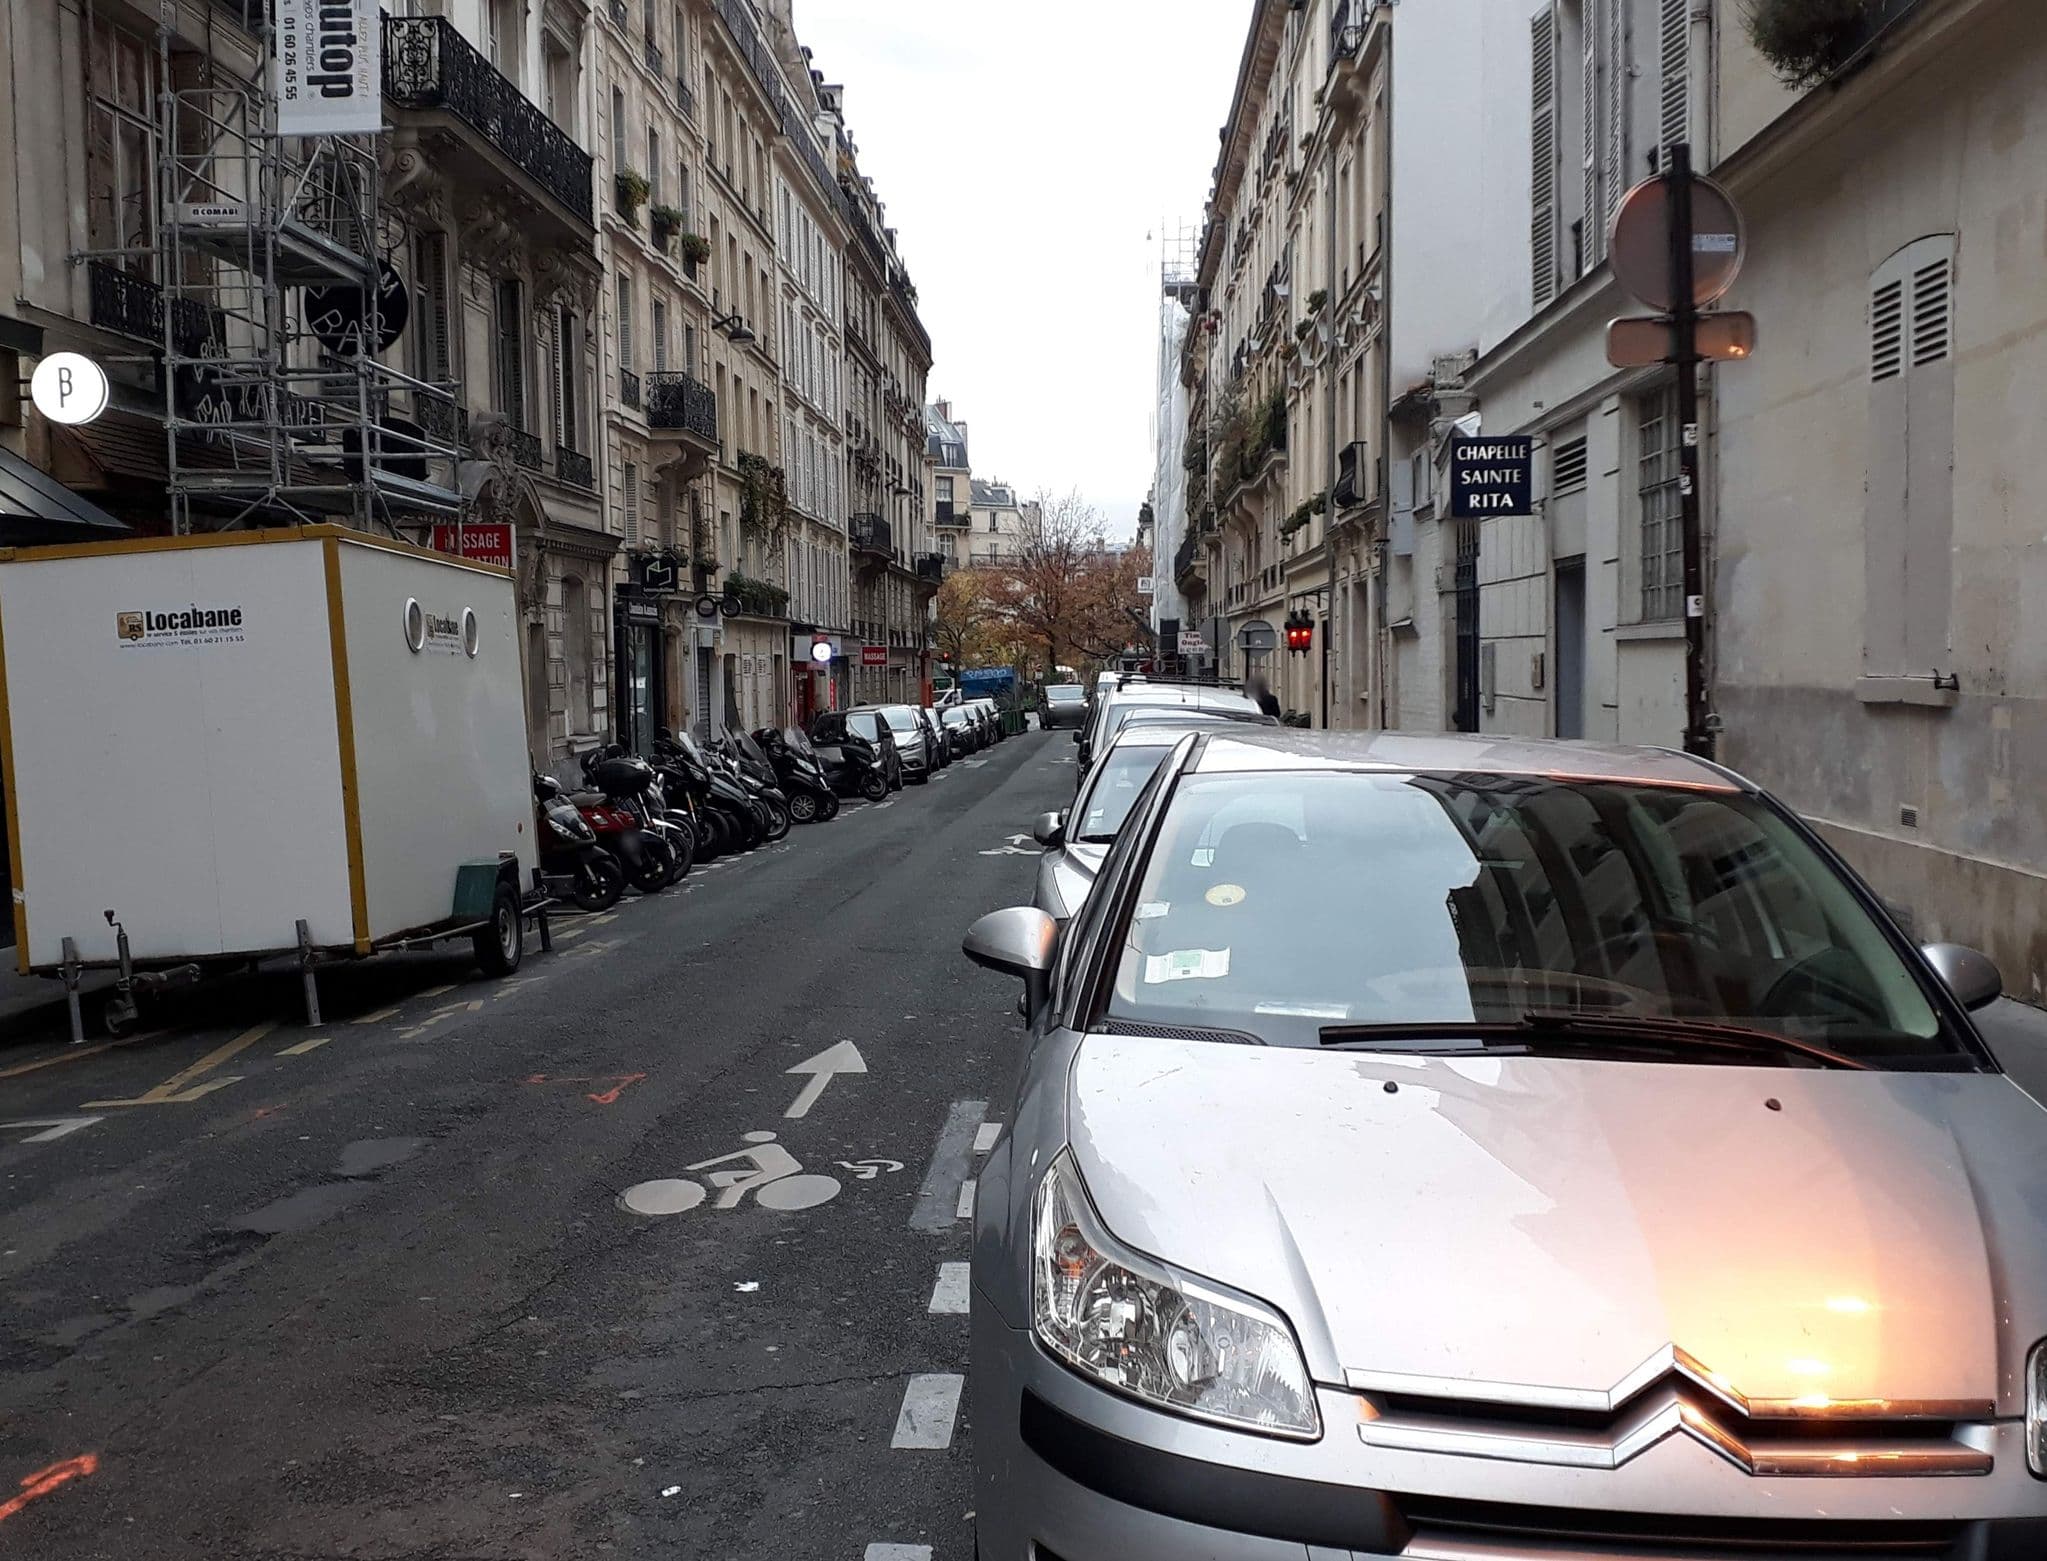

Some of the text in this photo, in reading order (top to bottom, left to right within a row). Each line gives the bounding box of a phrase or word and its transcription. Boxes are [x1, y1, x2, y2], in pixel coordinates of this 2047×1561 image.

[284, 17, 296, 30] 01
[284, 34, 296, 49] 60
[305, 22, 316, 72] chantiers
[306, 0, 358, 98] utop
[285, 51, 297, 66] 26
[286, 68, 297, 83] 45
[286, 85, 298, 100] 55
[1457, 444, 1527, 460] CHAPELLE
[1461, 469, 1521, 484] SAINTE
[1469, 493, 1514, 508] RITA
[145, 608, 242, 631] Locabane
